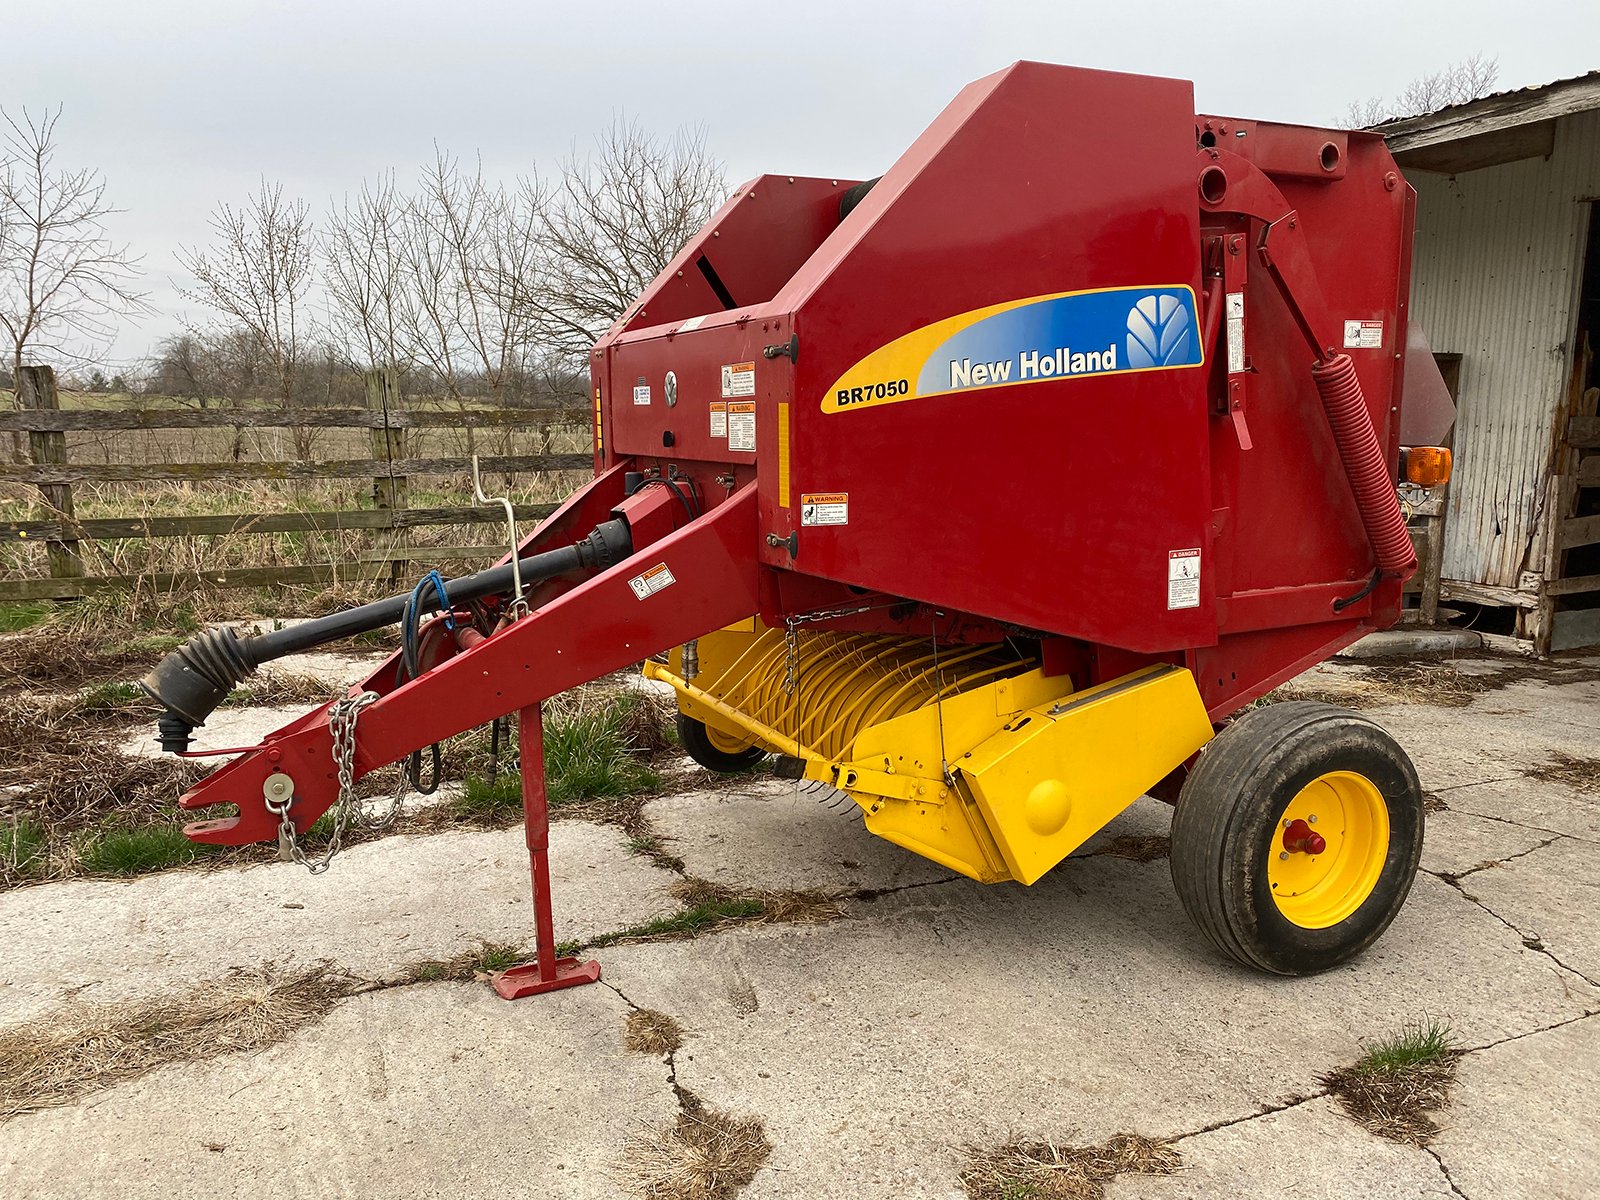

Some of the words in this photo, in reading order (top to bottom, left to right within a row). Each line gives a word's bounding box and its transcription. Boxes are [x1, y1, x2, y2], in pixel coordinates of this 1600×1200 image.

[949, 358, 1011, 388] New
[1018, 344, 1117, 378] Holland
[836, 379, 909, 406] BR7050
